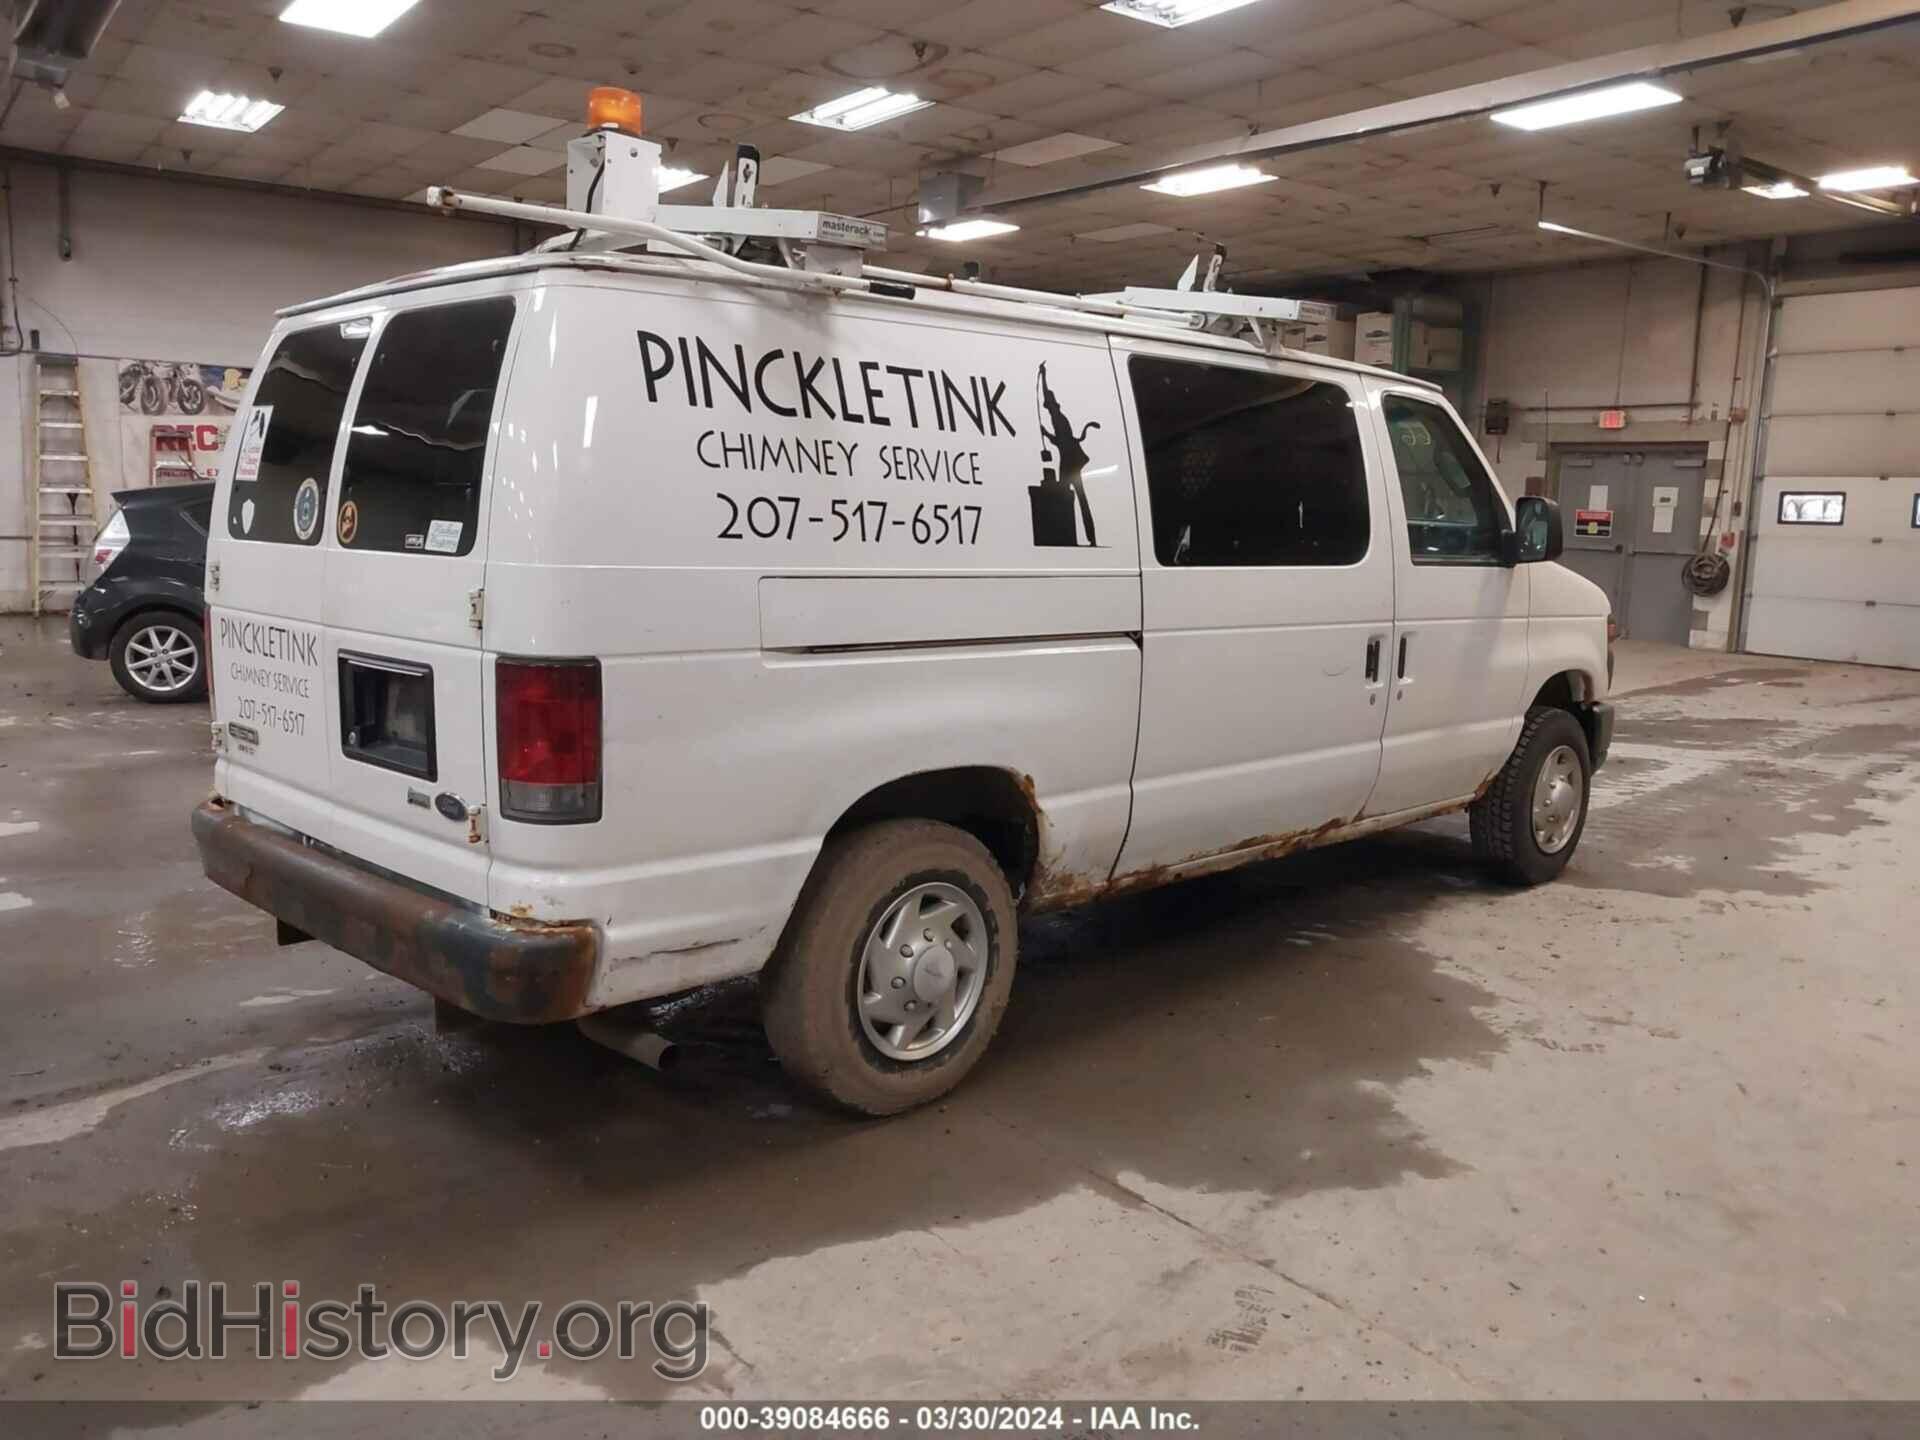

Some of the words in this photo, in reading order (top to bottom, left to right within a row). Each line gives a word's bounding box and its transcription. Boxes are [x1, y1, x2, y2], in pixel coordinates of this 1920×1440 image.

[822, 220, 870, 235] masterack
[637, 330, 1017, 438] PINCKLETINK
[697, 430, 859, 477] CHIMNEY
[879, 445, 983, 485] SERVICE
[716, 492, 983, 545] 207-517-6517
[220, 617, 319, 667] PINCKLETINK
[230, 662, 272, 689] CHIMNEY
[273, 672, 310, 699] SERVICE
[238, 696, 305, 737] 207-517-6517
